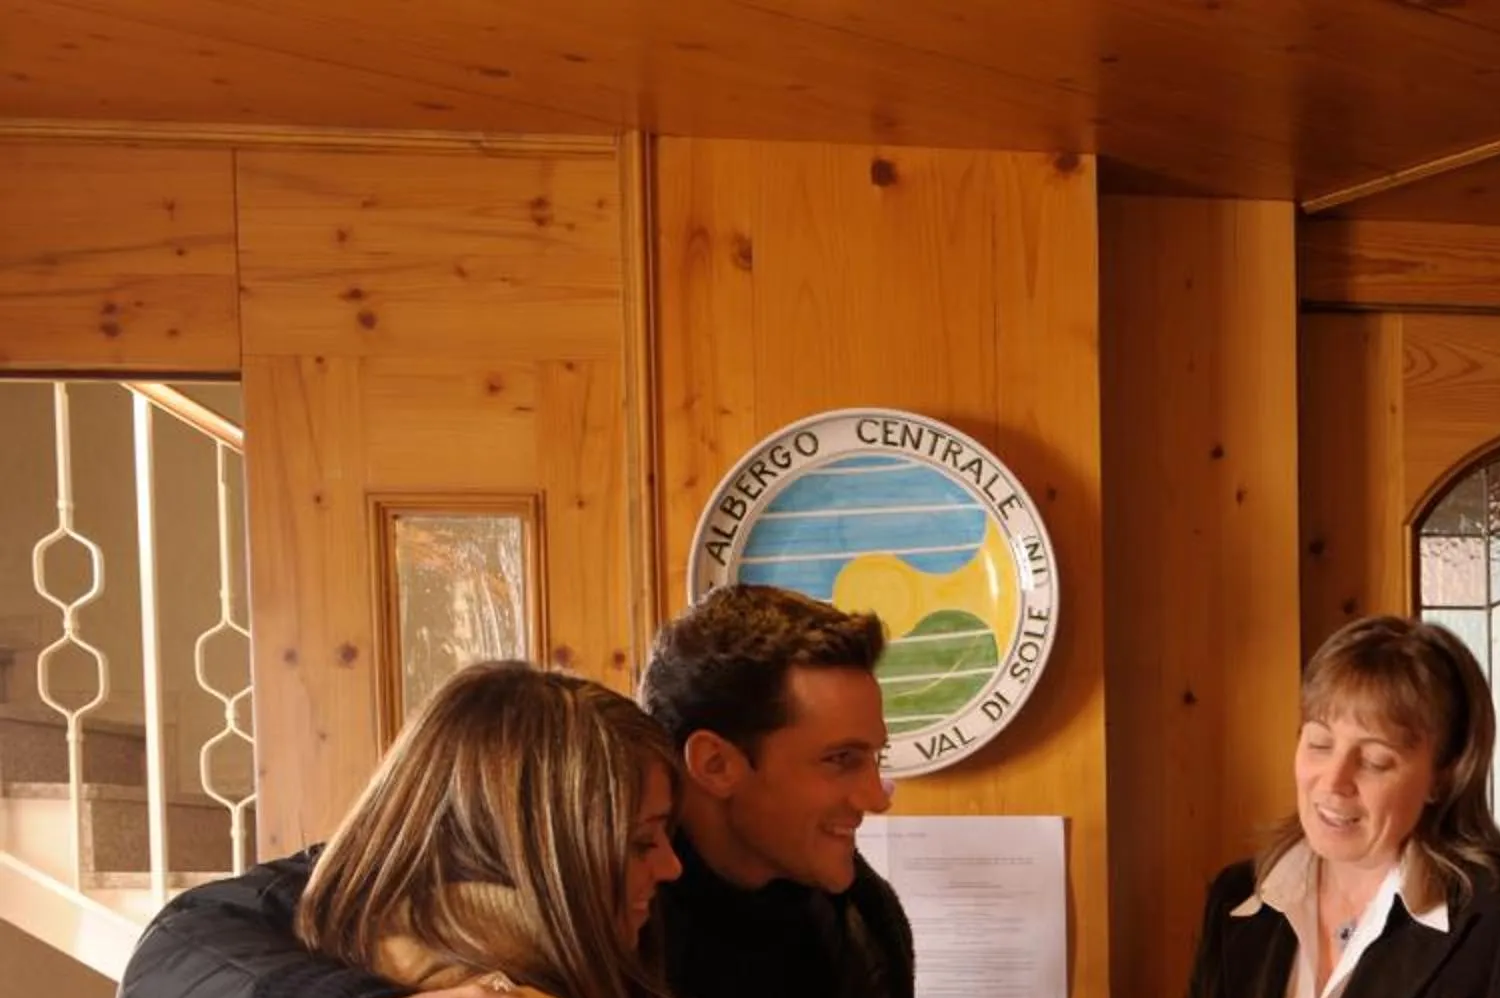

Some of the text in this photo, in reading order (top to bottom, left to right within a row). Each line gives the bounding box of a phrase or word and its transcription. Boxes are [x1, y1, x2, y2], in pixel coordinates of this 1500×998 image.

[705, 418, 1023, 566] ALBERGO CENTRALE
[914, 726, 976, 761] VAL
[981, 692, 1010, 721] DI
[1010, 607, 1050, 683] SOLE
